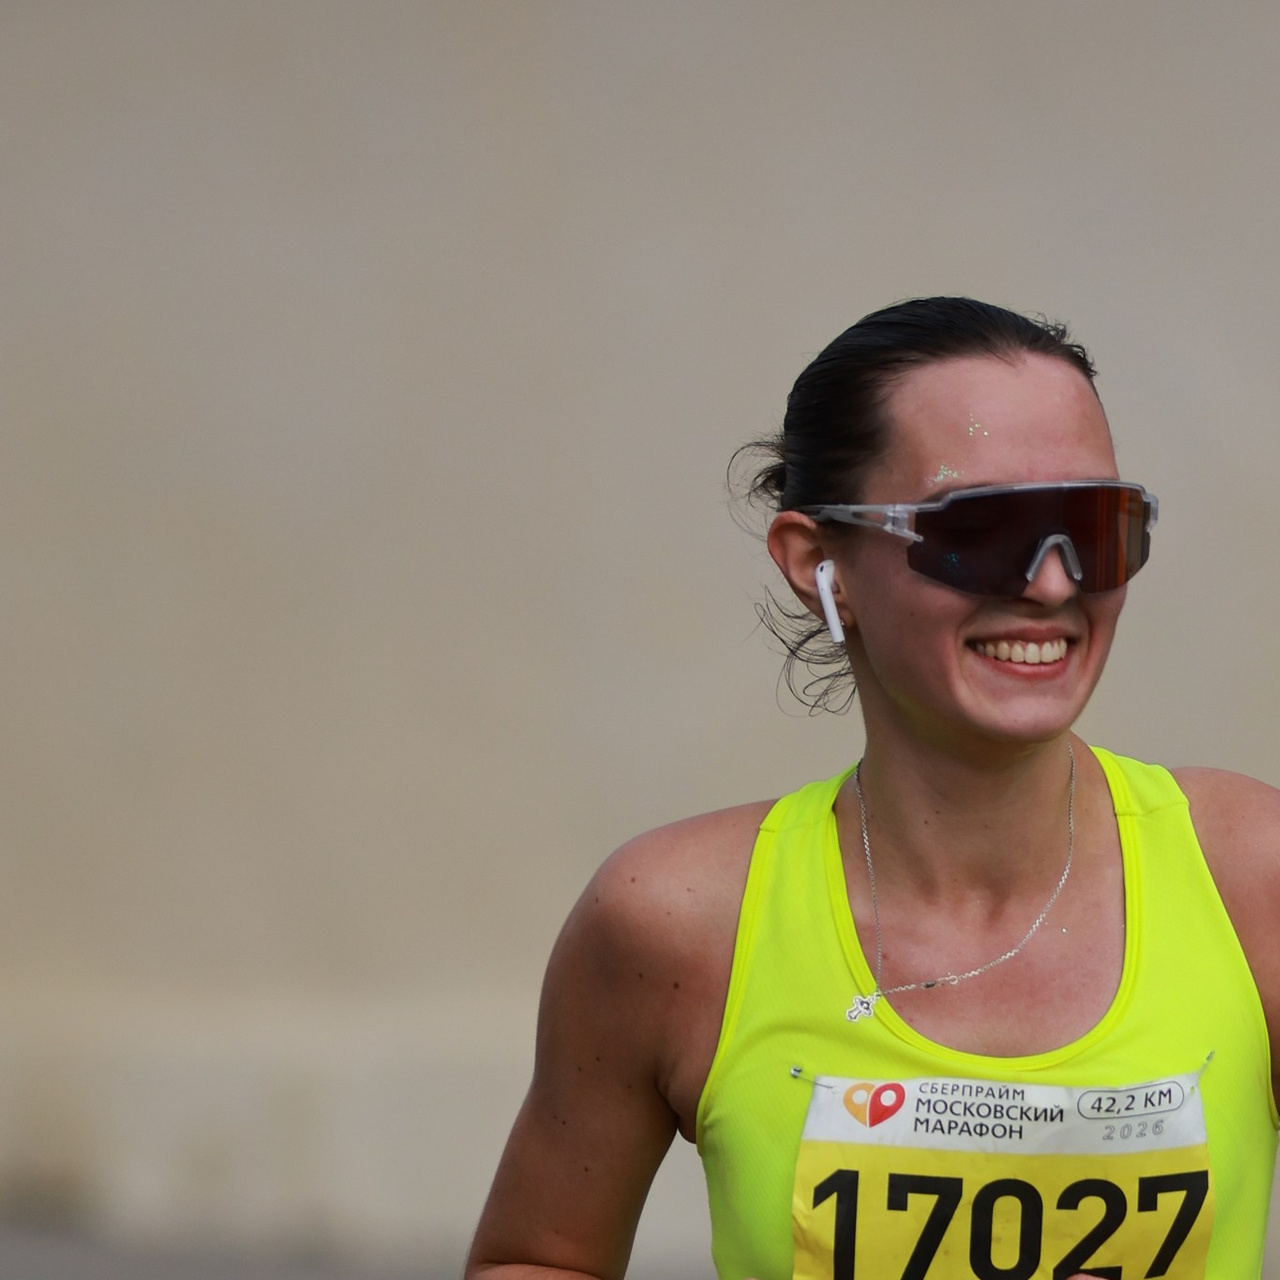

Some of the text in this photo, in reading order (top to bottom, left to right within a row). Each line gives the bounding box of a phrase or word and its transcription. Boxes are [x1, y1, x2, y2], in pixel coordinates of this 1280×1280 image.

[919, 1082, 1025, 1101] СБЕРПРАЙМ
[915, 1098, 1064, 1123] МОСКОВСКИЙ
[1091, 1095, 1136, 1115] 42,2
[913, 1117, 1023, 1140] МАРАФОН
[1102, 1120, 1164, 1141] 2026
